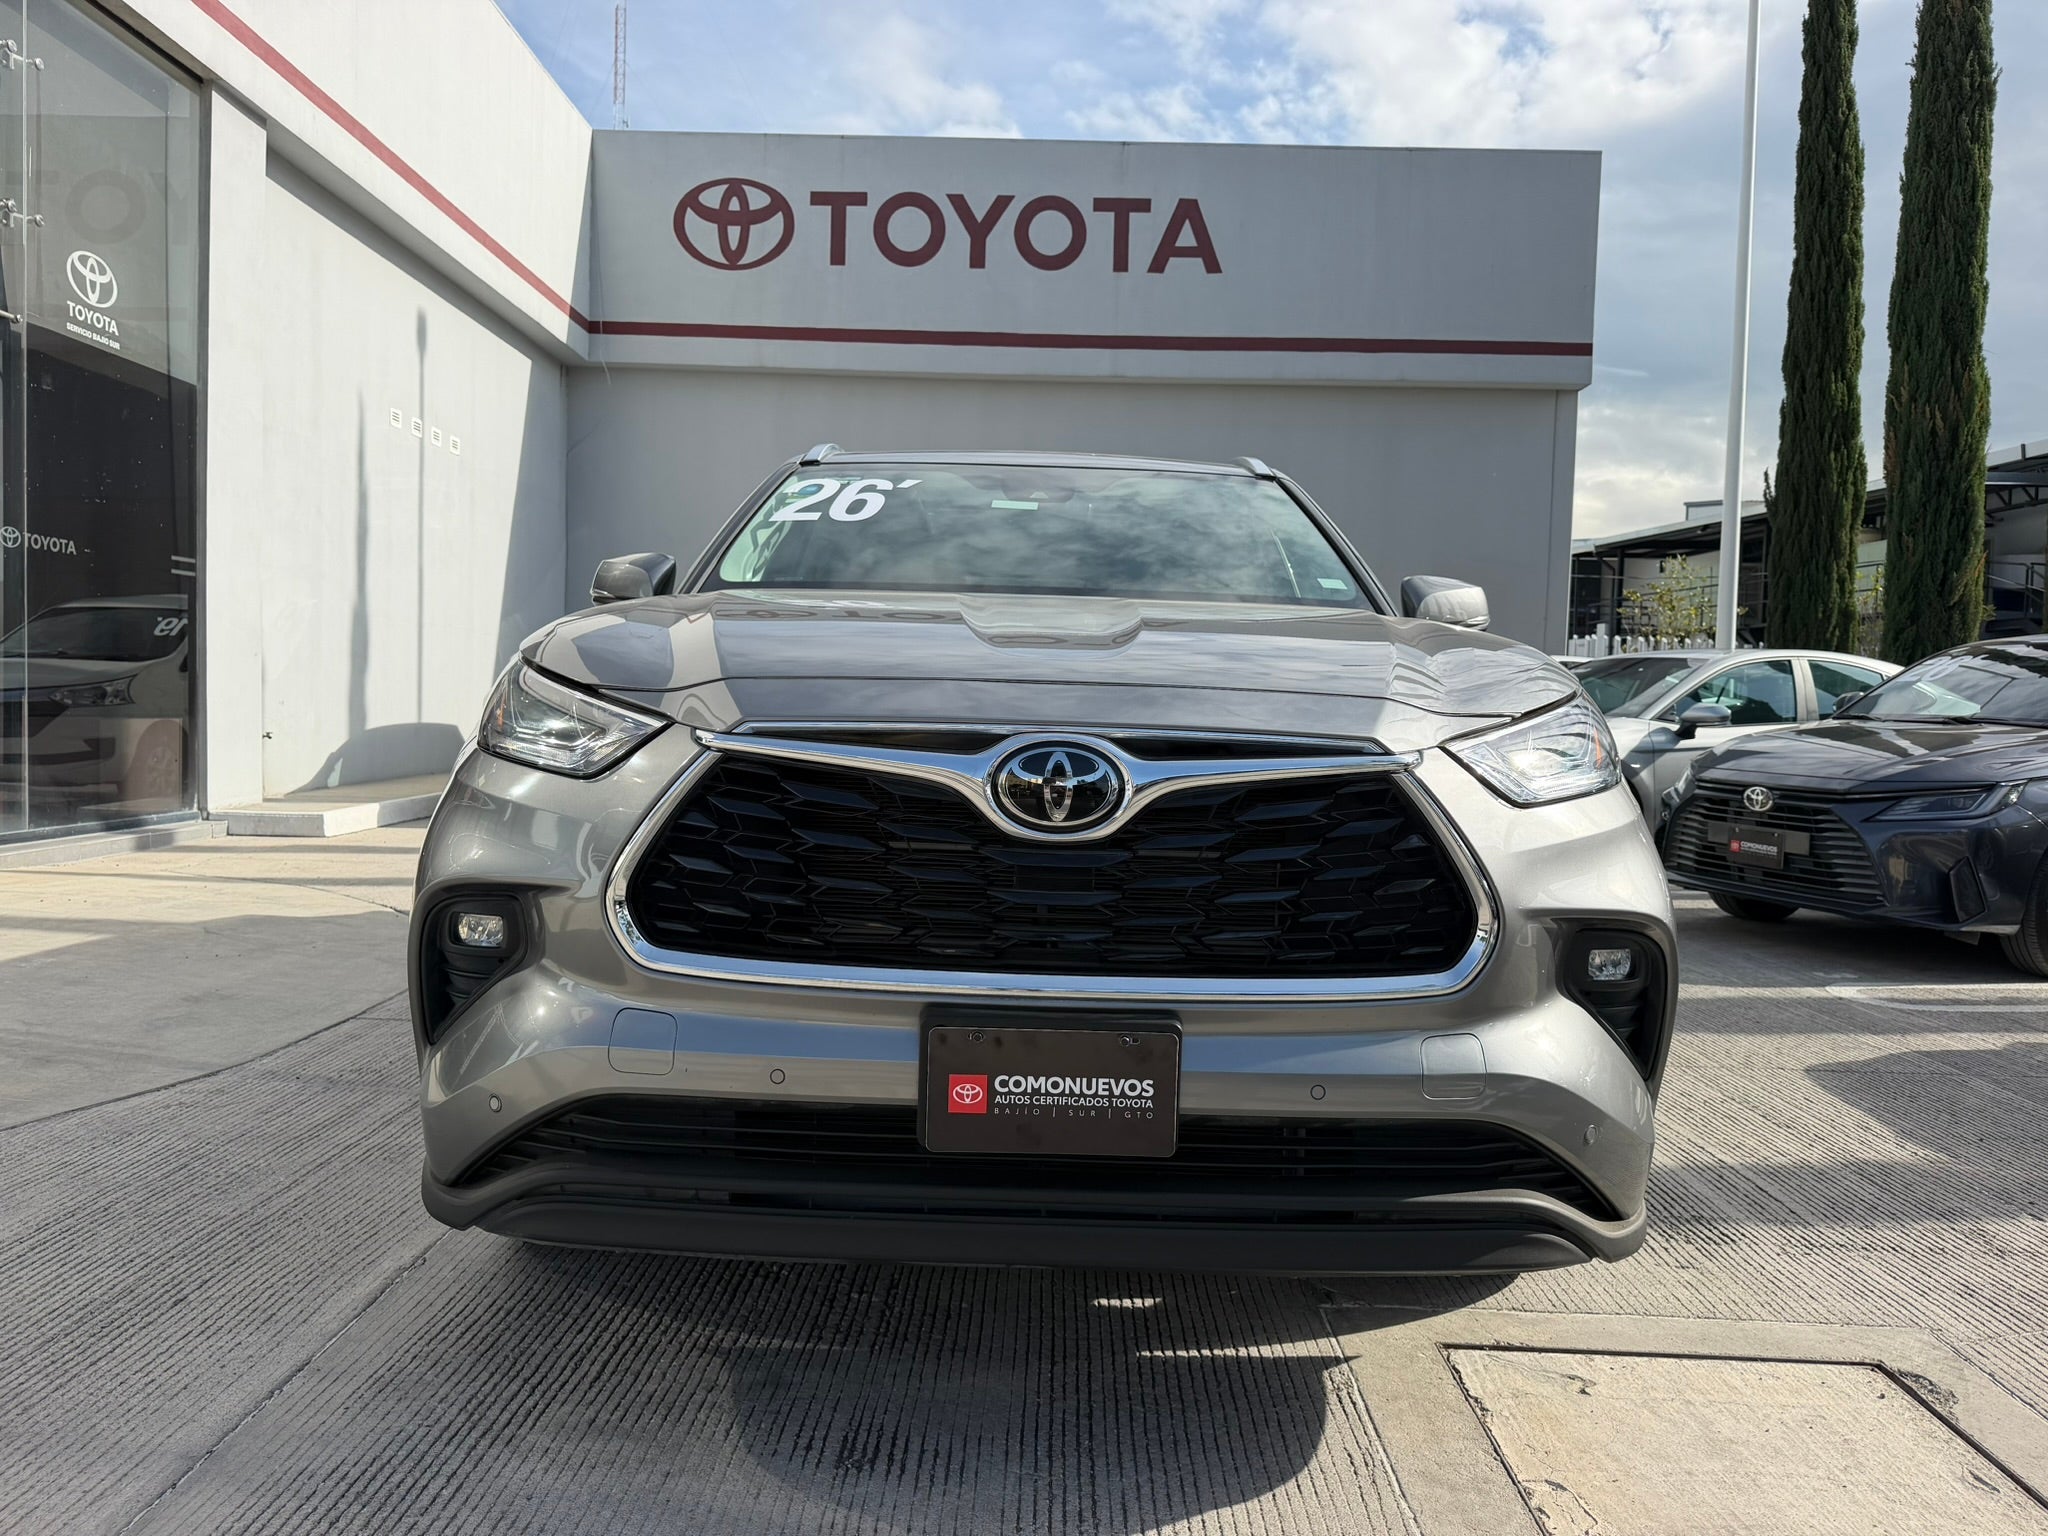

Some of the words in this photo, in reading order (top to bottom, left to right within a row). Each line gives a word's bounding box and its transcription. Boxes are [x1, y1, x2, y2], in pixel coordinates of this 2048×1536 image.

[809, 191, 1223, 274] TOYOTA
[67, 300, 119, 336] TOYOTA
[66, 322, 92, 339] SERVICIO
[109, 339, 120, 350] SUR
[22, 531, 77, 556] TOYOTA
[1740, 841, 1778, 853] COMONUEVOS
[994, 1075, 1155, 1097] COMONUEVOS
[994, 1094, 1031, 1105] AUTOS
[1032, 1095, 1109, 1107] CERTIFICADOS
[1111, 1098, 1154, 1108] TOYOTA
[1068, 1109, 1096, 1117] SUR
[1124, 1111, 1154, 1119] GTO
